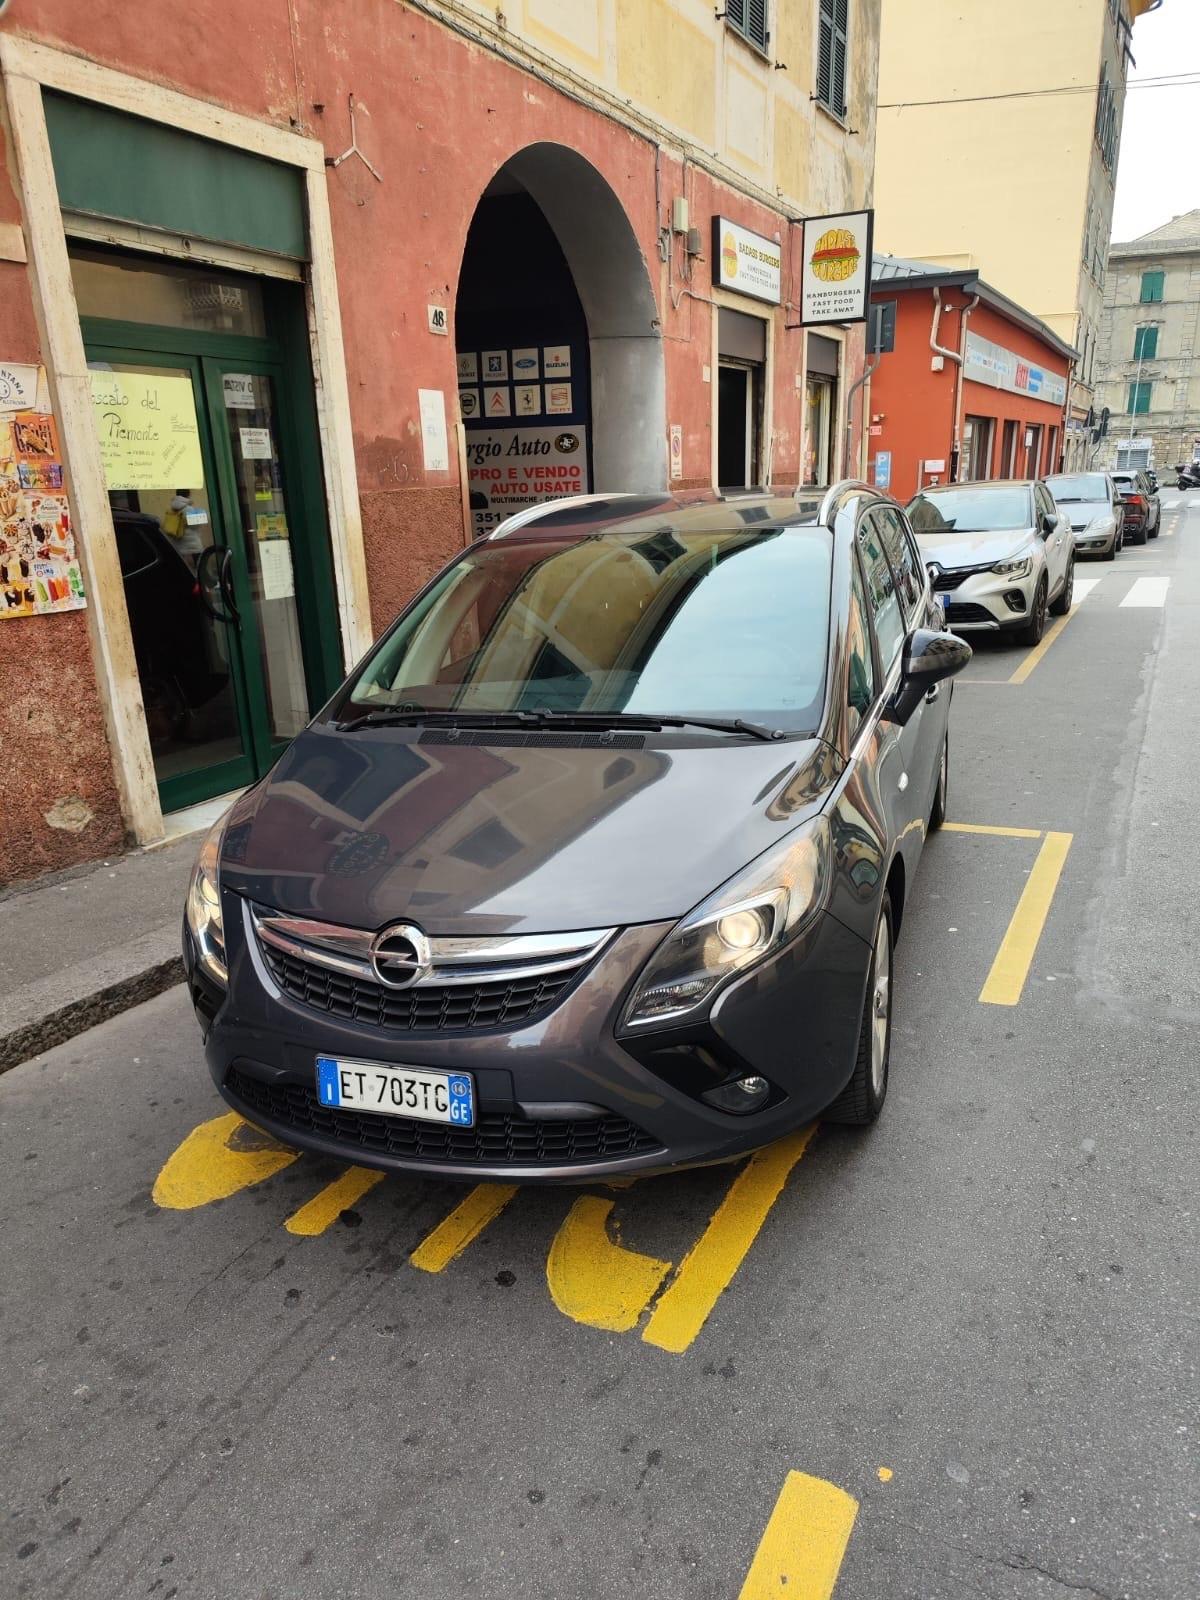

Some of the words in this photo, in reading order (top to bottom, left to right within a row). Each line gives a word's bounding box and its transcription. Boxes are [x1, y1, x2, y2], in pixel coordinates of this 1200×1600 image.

[806, 288, 861, 299] HAMBURGERIA
[812, 299, 832, 307] FAST
[812, 308, 832, 316] TAKE
[833, 306, 855, 314] AWAY
[141, 389, 161, 411] del
[102, 412, 159, 441] Piemonte
[506, 434, 551, 456] Auto
[508, 467, 518, 479] E
[523, 466, 581, 479] VENDO
[490, 482, 529, 494] AUTO
[533, 480, 581, 493] USATE
[490, 496, 538, 504] MULTIMARCHE
[476, 512, 501, 523] 351
[340, 1070, 367, 1100] ET
[375, 1074, 448, 1113] 703TG
[451, 1102, 468, 1122] GE
